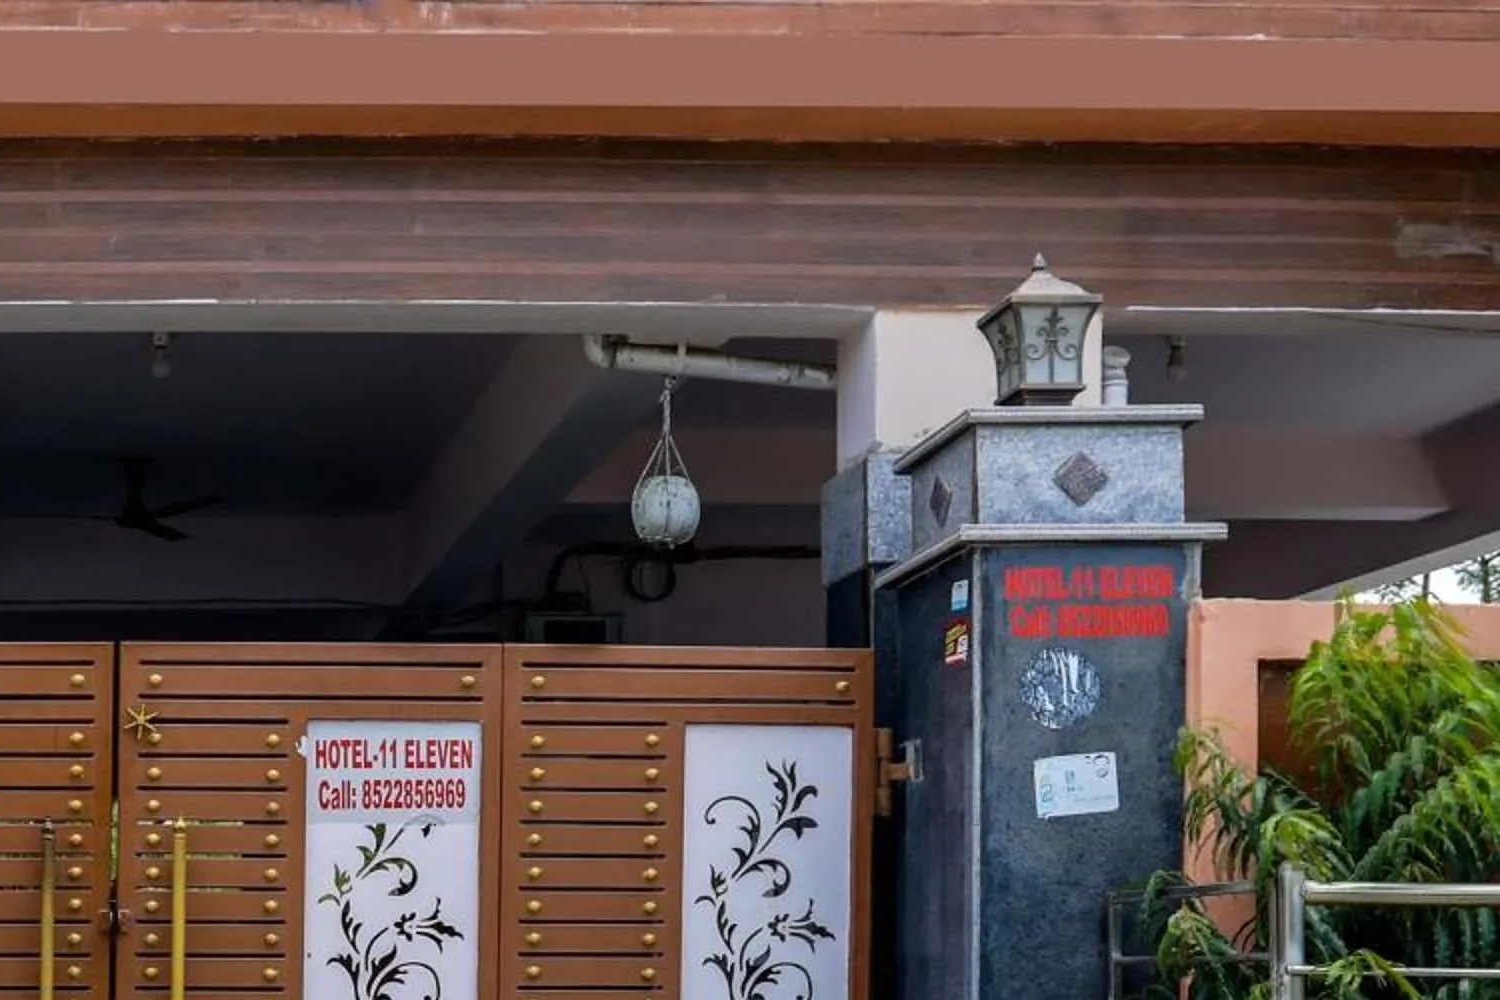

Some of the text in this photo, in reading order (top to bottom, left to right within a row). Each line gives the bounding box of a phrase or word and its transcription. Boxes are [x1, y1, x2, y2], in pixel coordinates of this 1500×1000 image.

[404, 739, 473, 769] ELEVEN
[319, 778, 466, 810] Call: 8522856969
